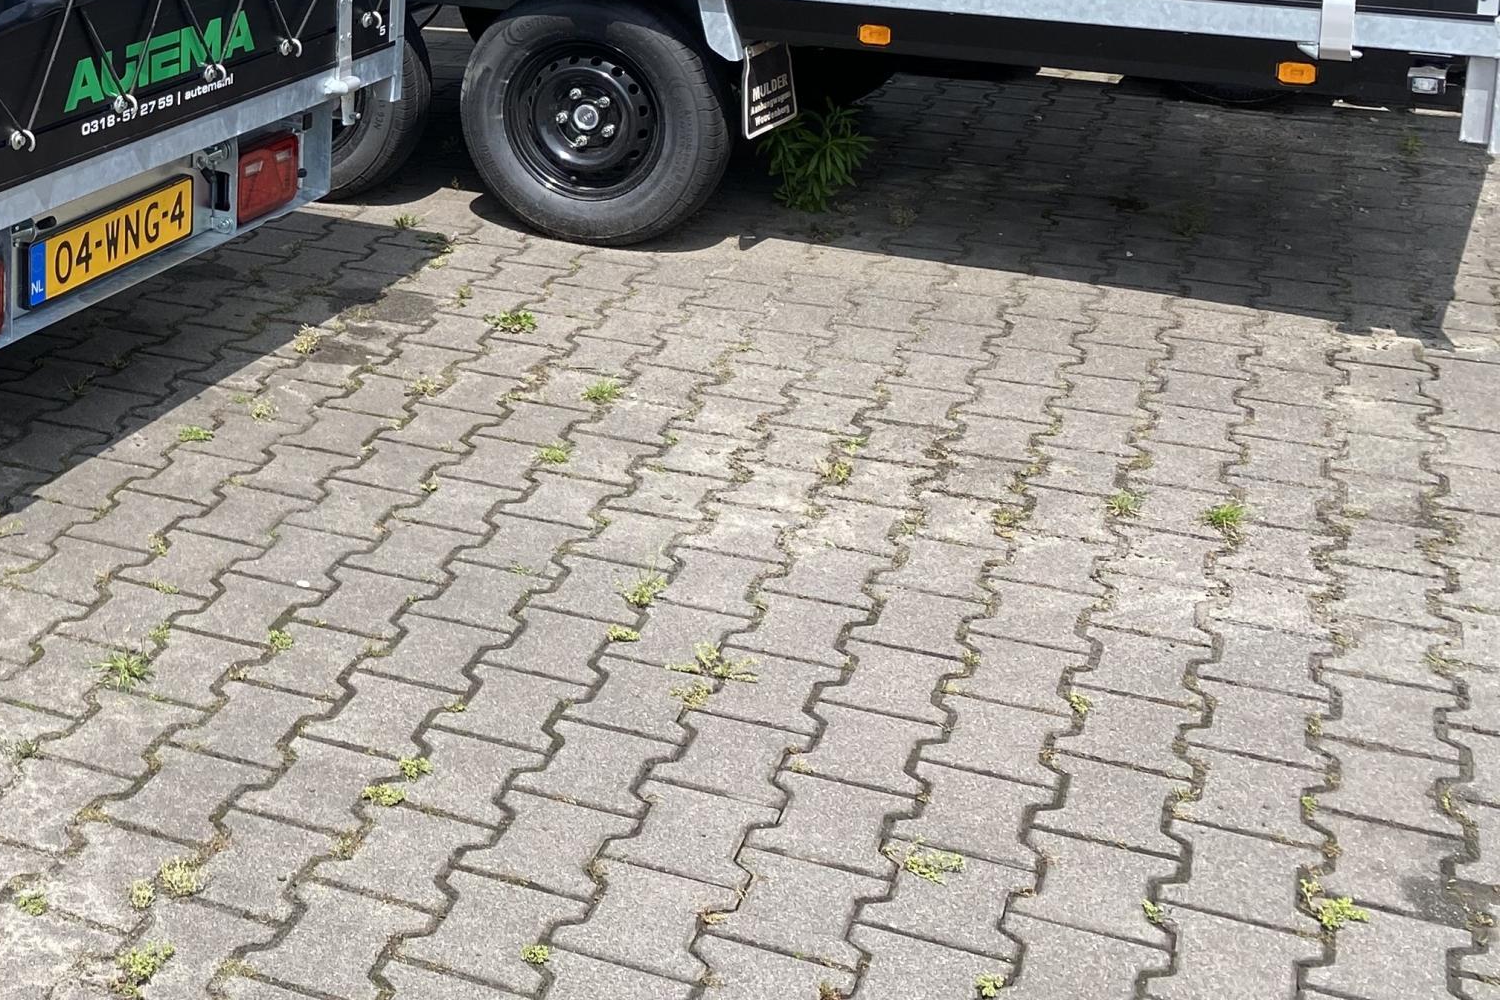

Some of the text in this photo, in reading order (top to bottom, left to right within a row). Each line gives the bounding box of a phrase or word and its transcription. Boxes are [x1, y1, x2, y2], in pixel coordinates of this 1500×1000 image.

[64, 9, 255, 113] AUTEMA
[184, 73, 234, 100] autema.nl
[752, 73, 789, 103] MULDER
[54, 191, 185, 284] 04-WNG-4
[31, 279, 44, 296] NL
